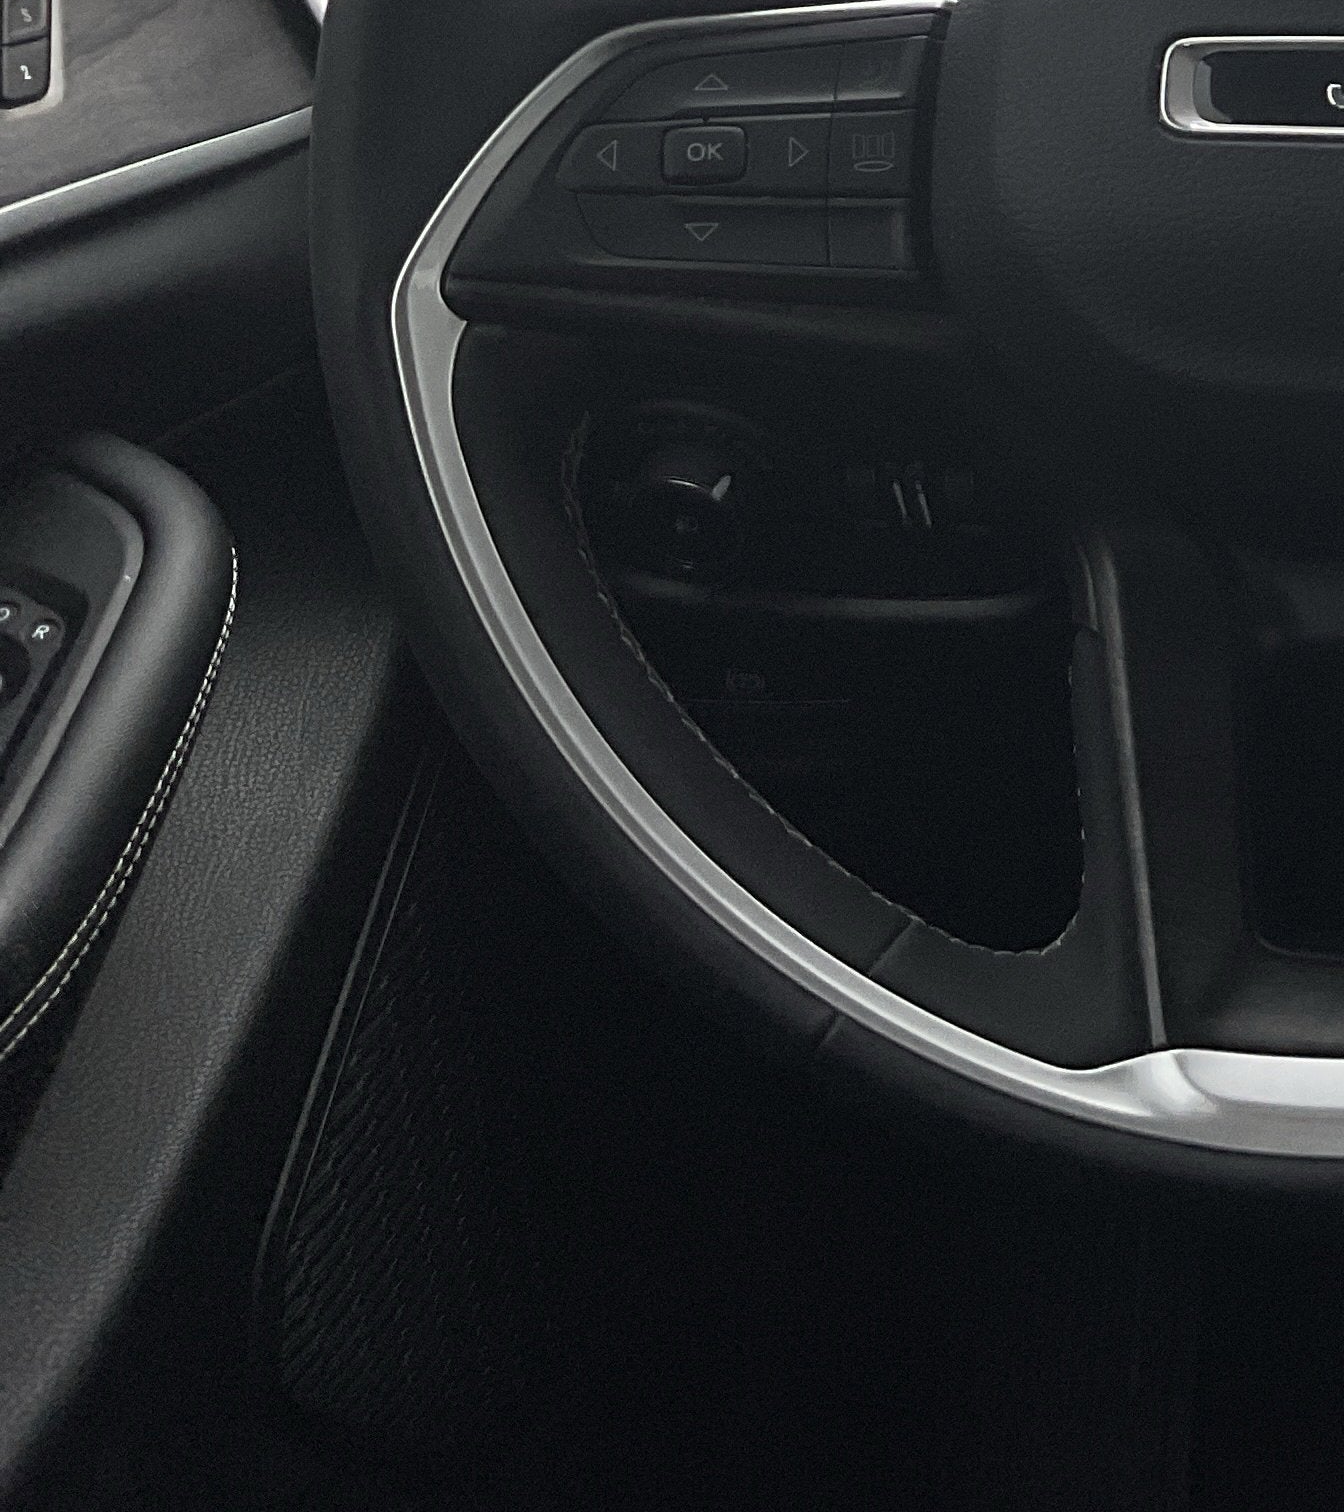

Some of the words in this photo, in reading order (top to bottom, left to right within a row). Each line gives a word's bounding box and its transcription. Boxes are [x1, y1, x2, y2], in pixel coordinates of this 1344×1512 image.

[19, 64, 33, 80] 2
[686, 142, 725, 163] OK
[31, 624, 50, 640] R
